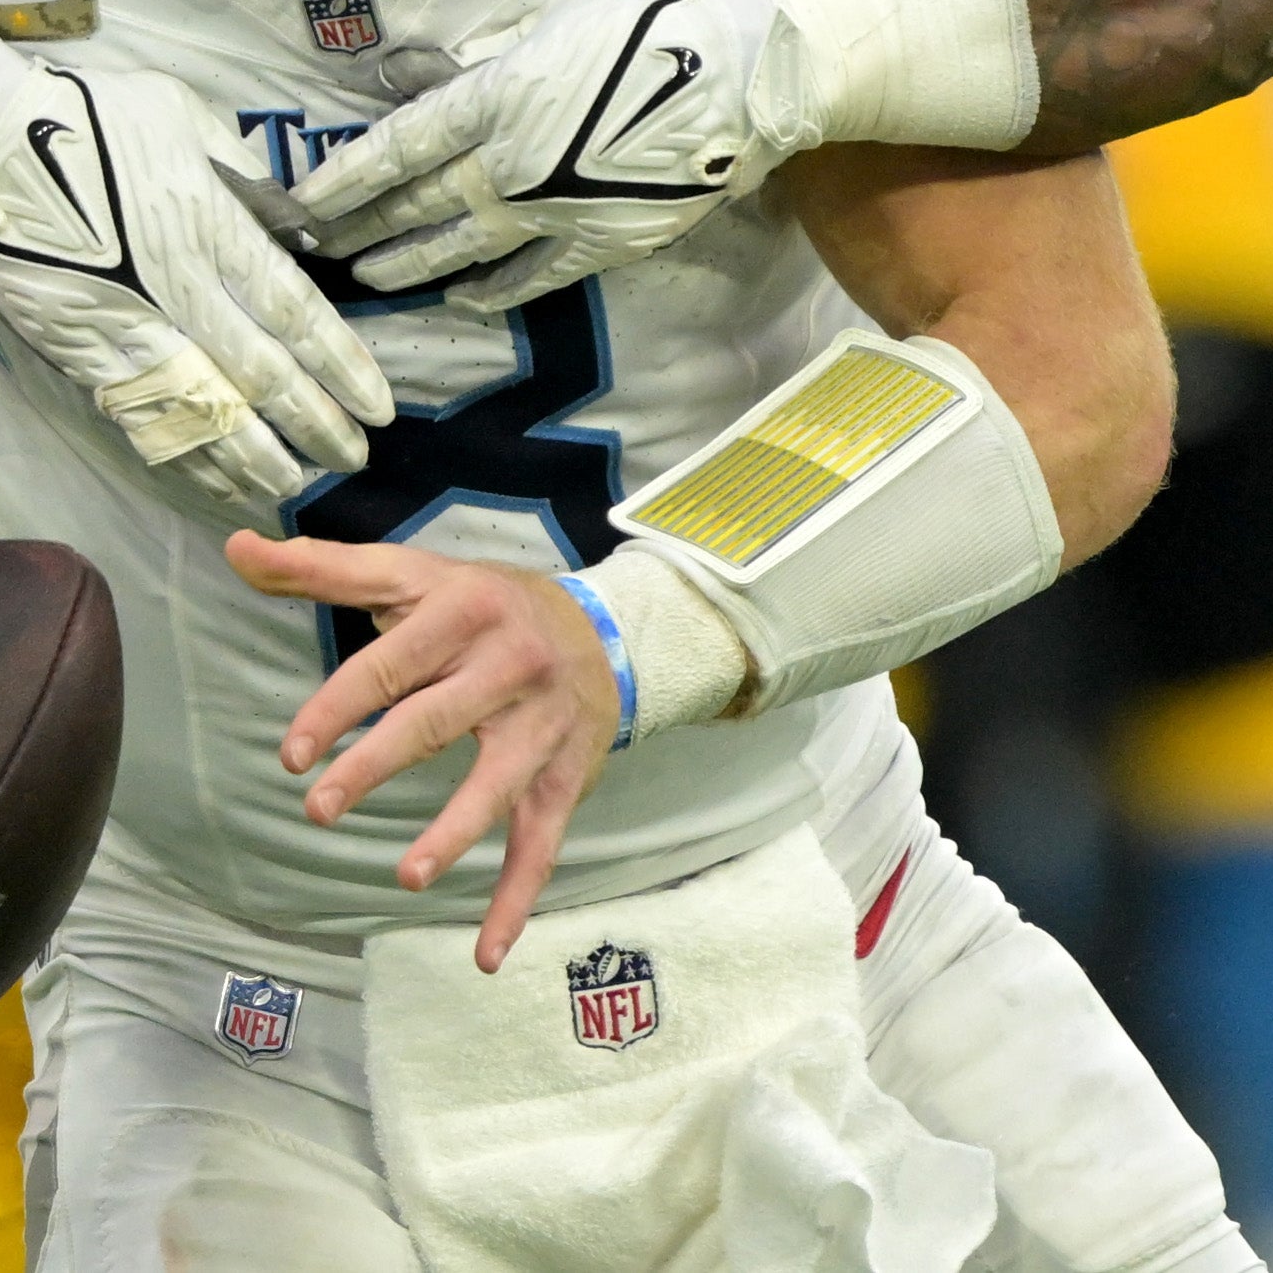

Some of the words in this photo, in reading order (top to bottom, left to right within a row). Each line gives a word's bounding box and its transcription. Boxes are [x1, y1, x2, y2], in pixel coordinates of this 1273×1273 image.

[316, 17, 376, 49] NFL
[229, 1006, 281, 1047] NFL
[577, 985, 653, 1043] NFL
